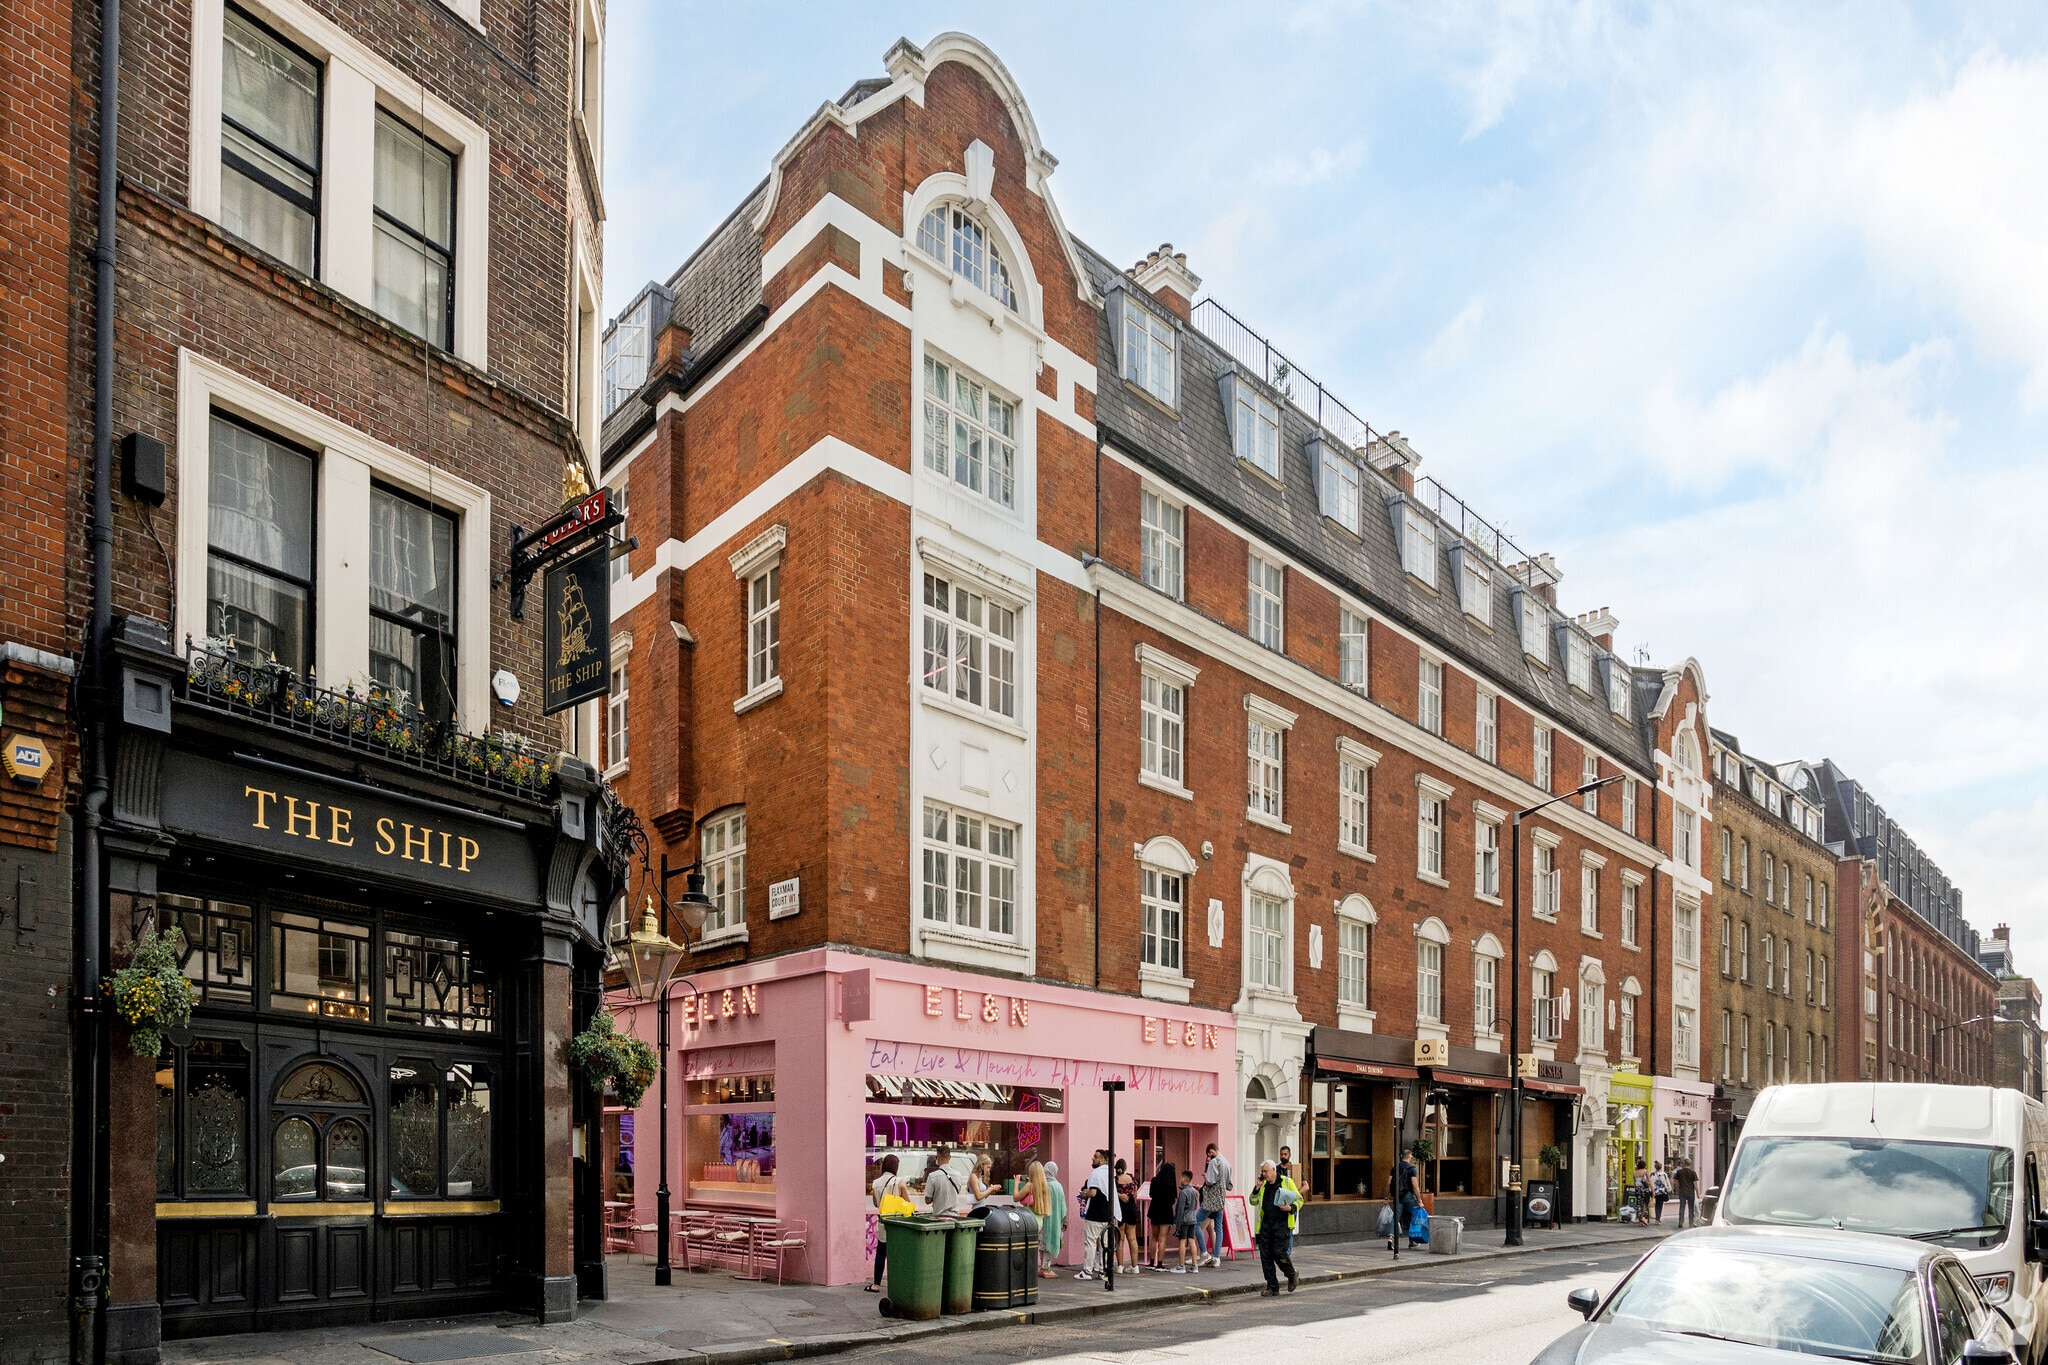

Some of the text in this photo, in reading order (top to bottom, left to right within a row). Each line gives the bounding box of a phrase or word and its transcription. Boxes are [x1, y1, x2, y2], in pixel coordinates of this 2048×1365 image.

[549, 660, 603, 694] THE SHIP
[16, 750, 40, 763] ADT
[245, 785, 480, 873] THE SHIP
[771, 883, 794, 897] FLAXMAN
[771, 895, 787, 908] COURT
[951, 1022, 999, 1036] LONDON
[913, 1043, 945, 1074] Live
[955, 1048, 972, 1073] &
[977, 1050, 1040, 1082] Nourish
[1356, 1065, 1384, 1075] THAI DINING
[1128, 1065, 1147, 1091] &
[1149, 1067, 1210, 1095] Nourish
